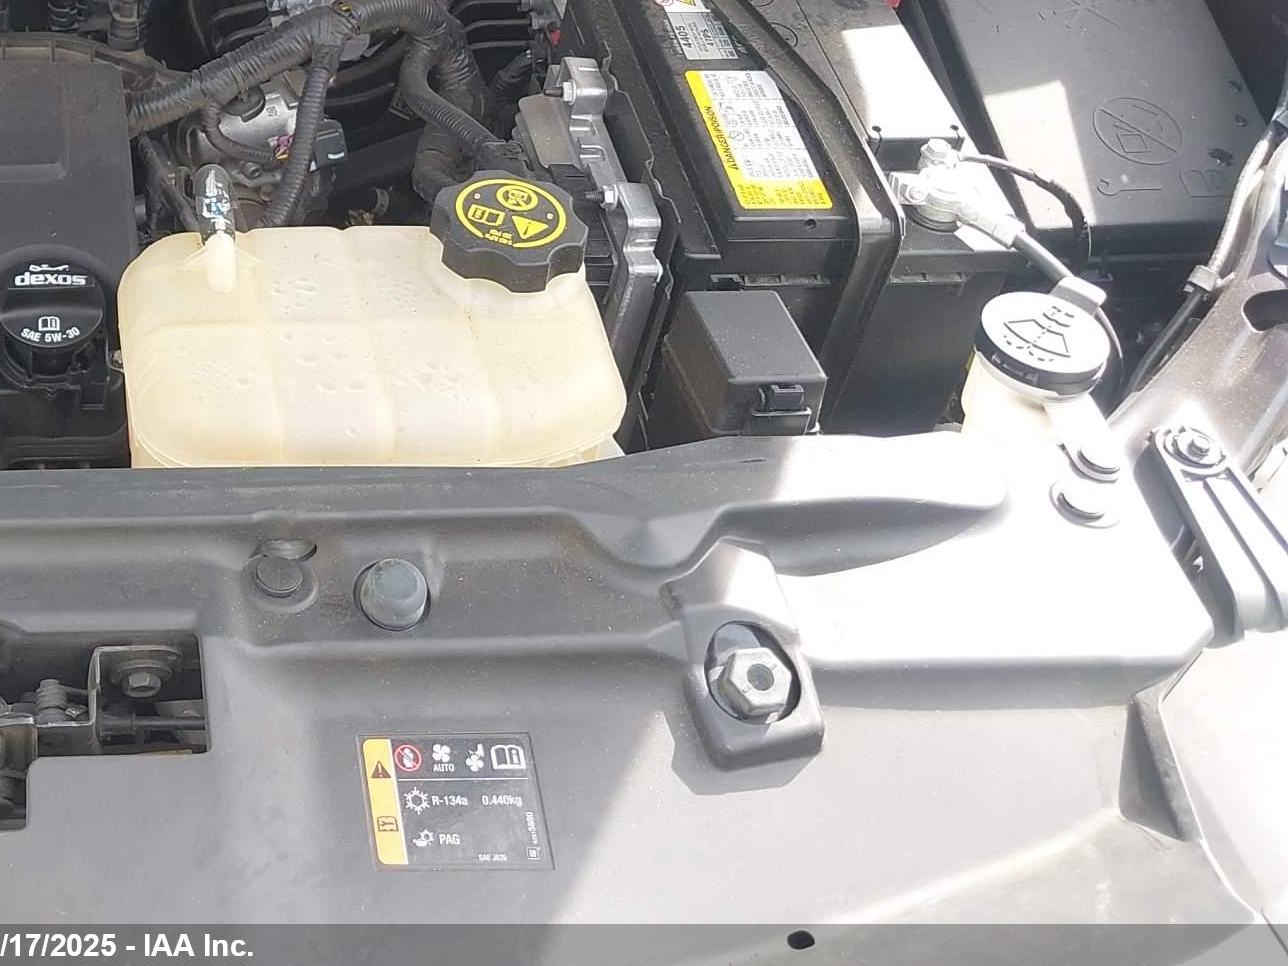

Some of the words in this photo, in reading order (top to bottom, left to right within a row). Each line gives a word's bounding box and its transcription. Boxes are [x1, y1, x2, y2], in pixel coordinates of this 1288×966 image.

[675, 25, 692, 48] 4405
[15, 272, 88, 286] dexos
[21, 328, 41, 342] SAE
[45, 327, 80, 343] 5W-30
[433, 763, 455, 772] AUTO
[432, 795, 468, 806] R-134a
[482, 795, 522, 807] 0.440kg
[439, 833, 460, 845] PAG
